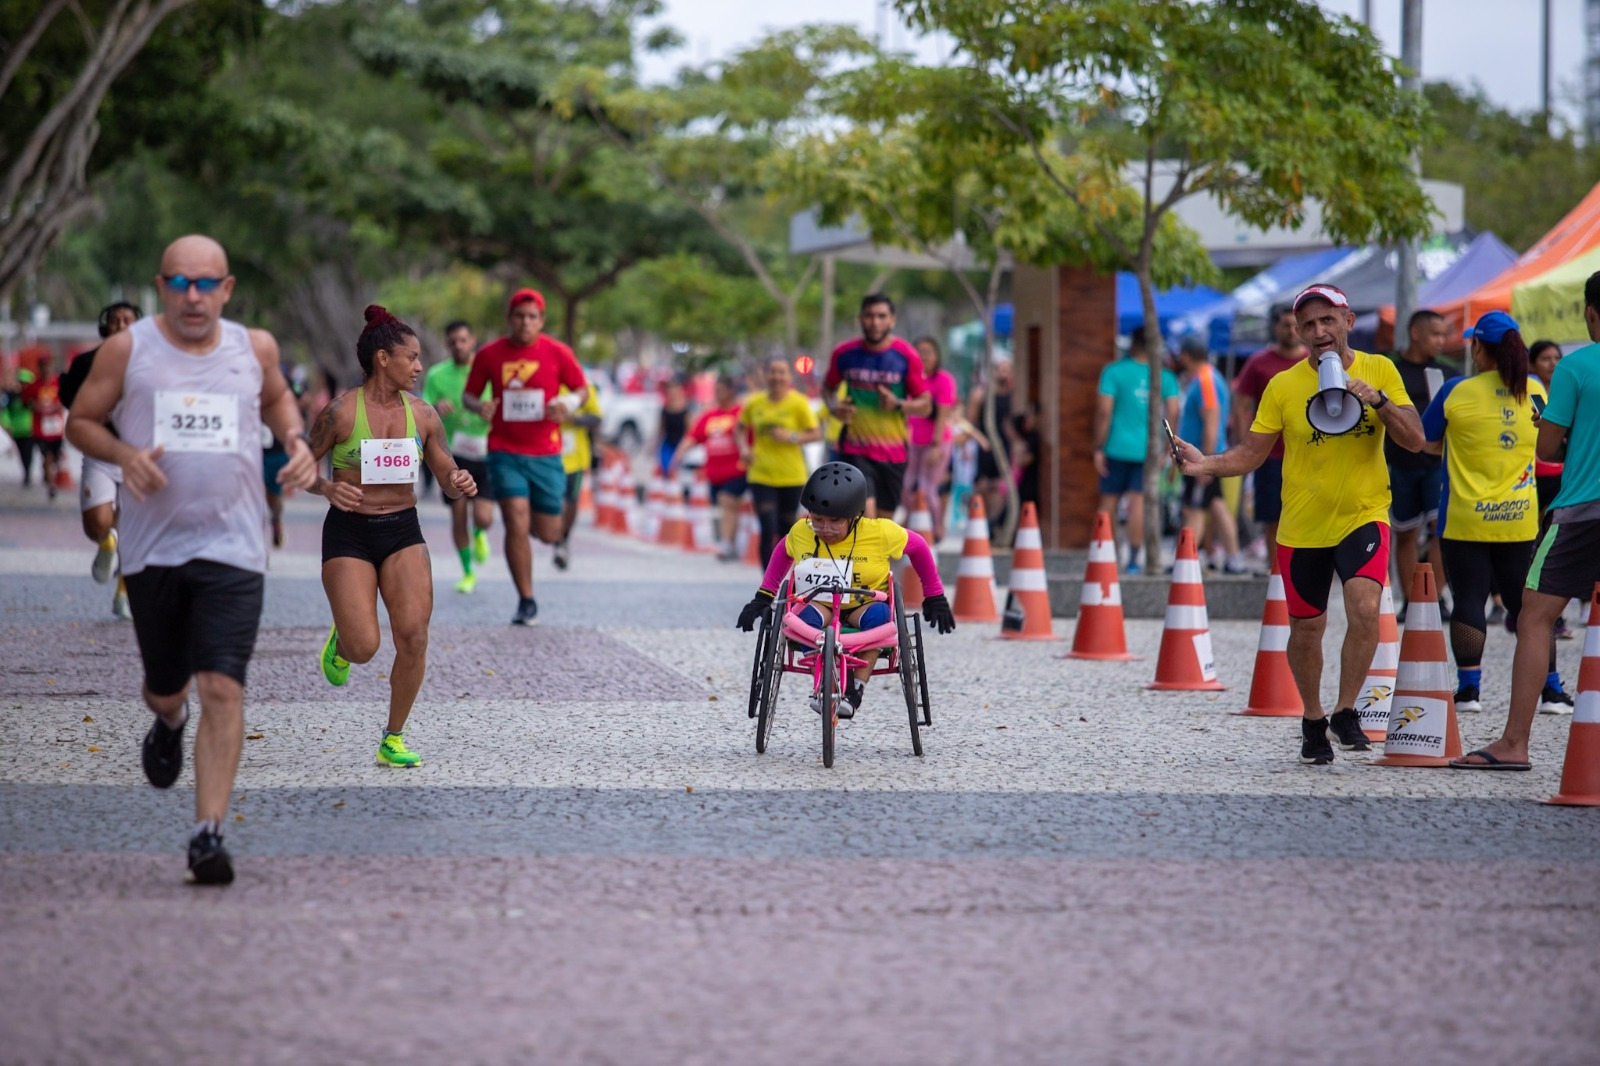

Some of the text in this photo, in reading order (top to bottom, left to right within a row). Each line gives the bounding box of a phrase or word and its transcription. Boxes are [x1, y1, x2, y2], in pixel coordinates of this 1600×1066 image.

[171, 413, 222, 431] 3235
[373, 455, 411, 468] 1968
[1475, 500, 1530, 512] BABISCO'S
[1483, 511, 1524, 521] RUNNERS
[805, 574, 840, 586] 4725
[1387, 733, 1442, 744] NDURANCE
